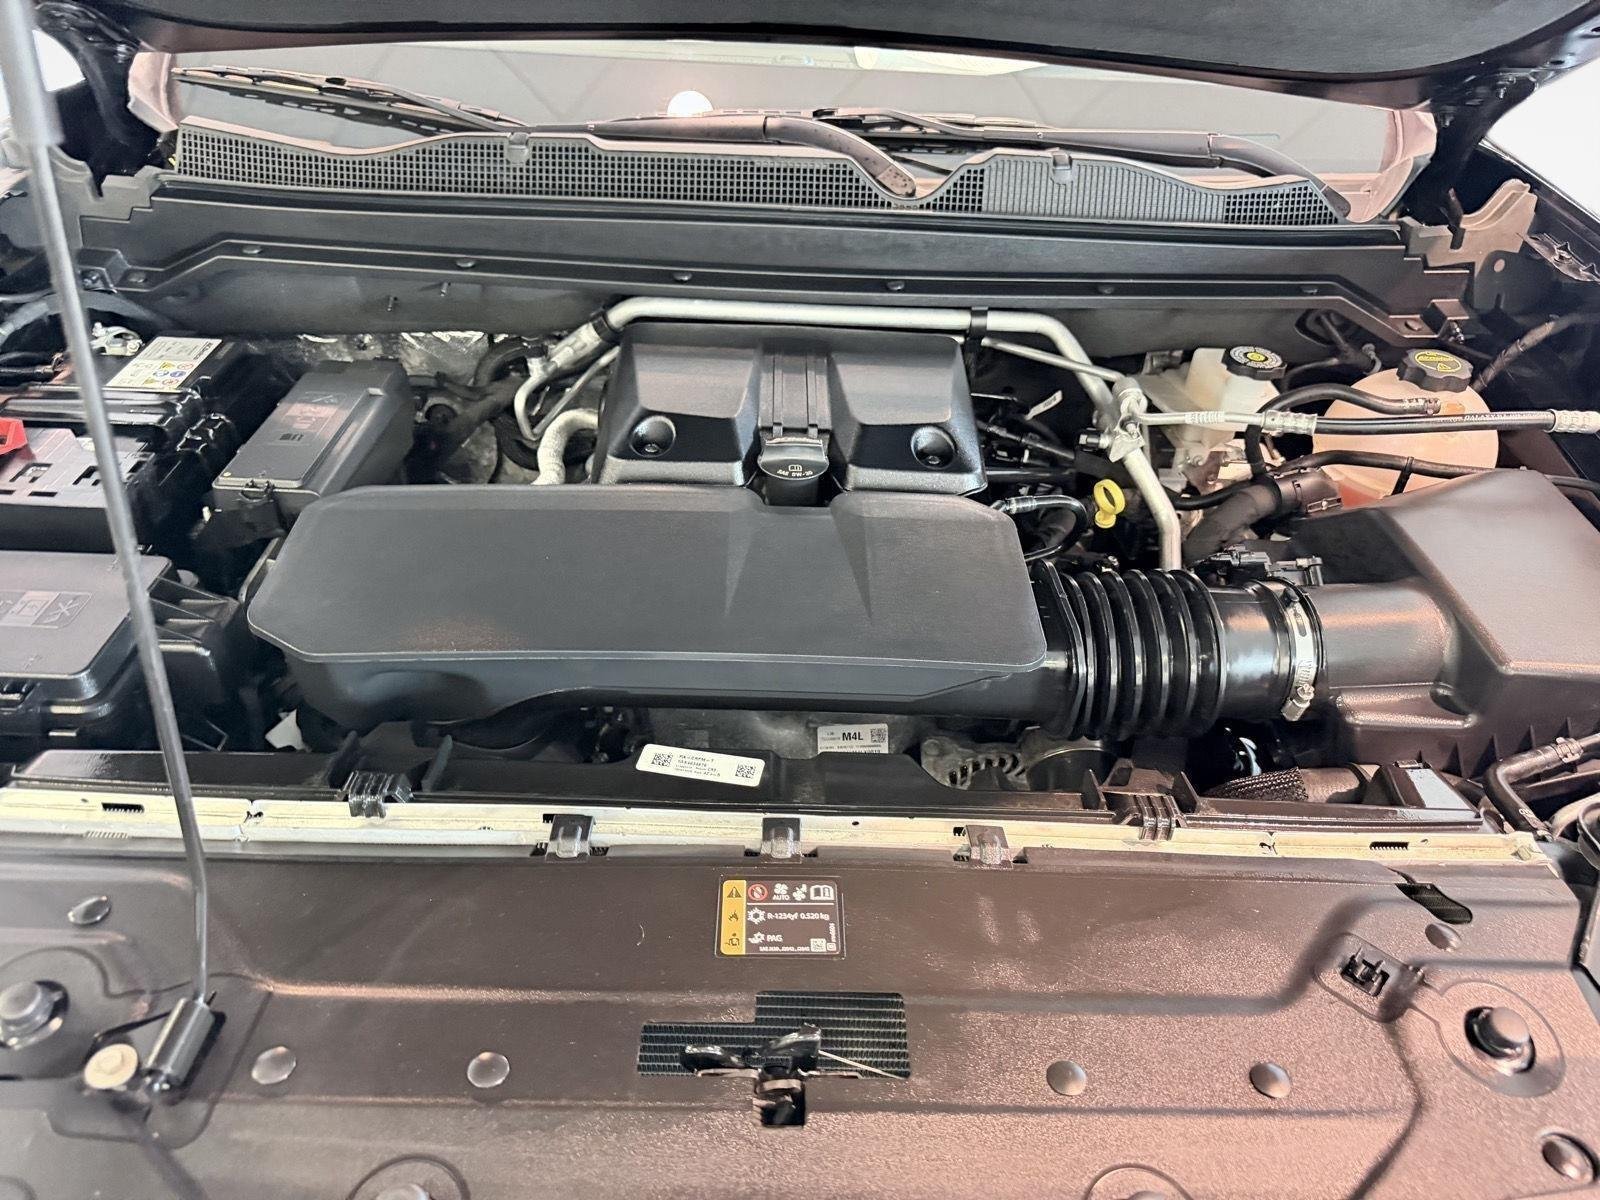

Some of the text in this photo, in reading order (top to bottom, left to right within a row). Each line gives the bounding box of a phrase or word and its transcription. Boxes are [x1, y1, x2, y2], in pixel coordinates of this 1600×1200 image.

[842, 732, 864, 741] M4L
[767, 912, 829, 921] R-1234yf 0.520 kg
[767, 934, 783, 942] PAG
